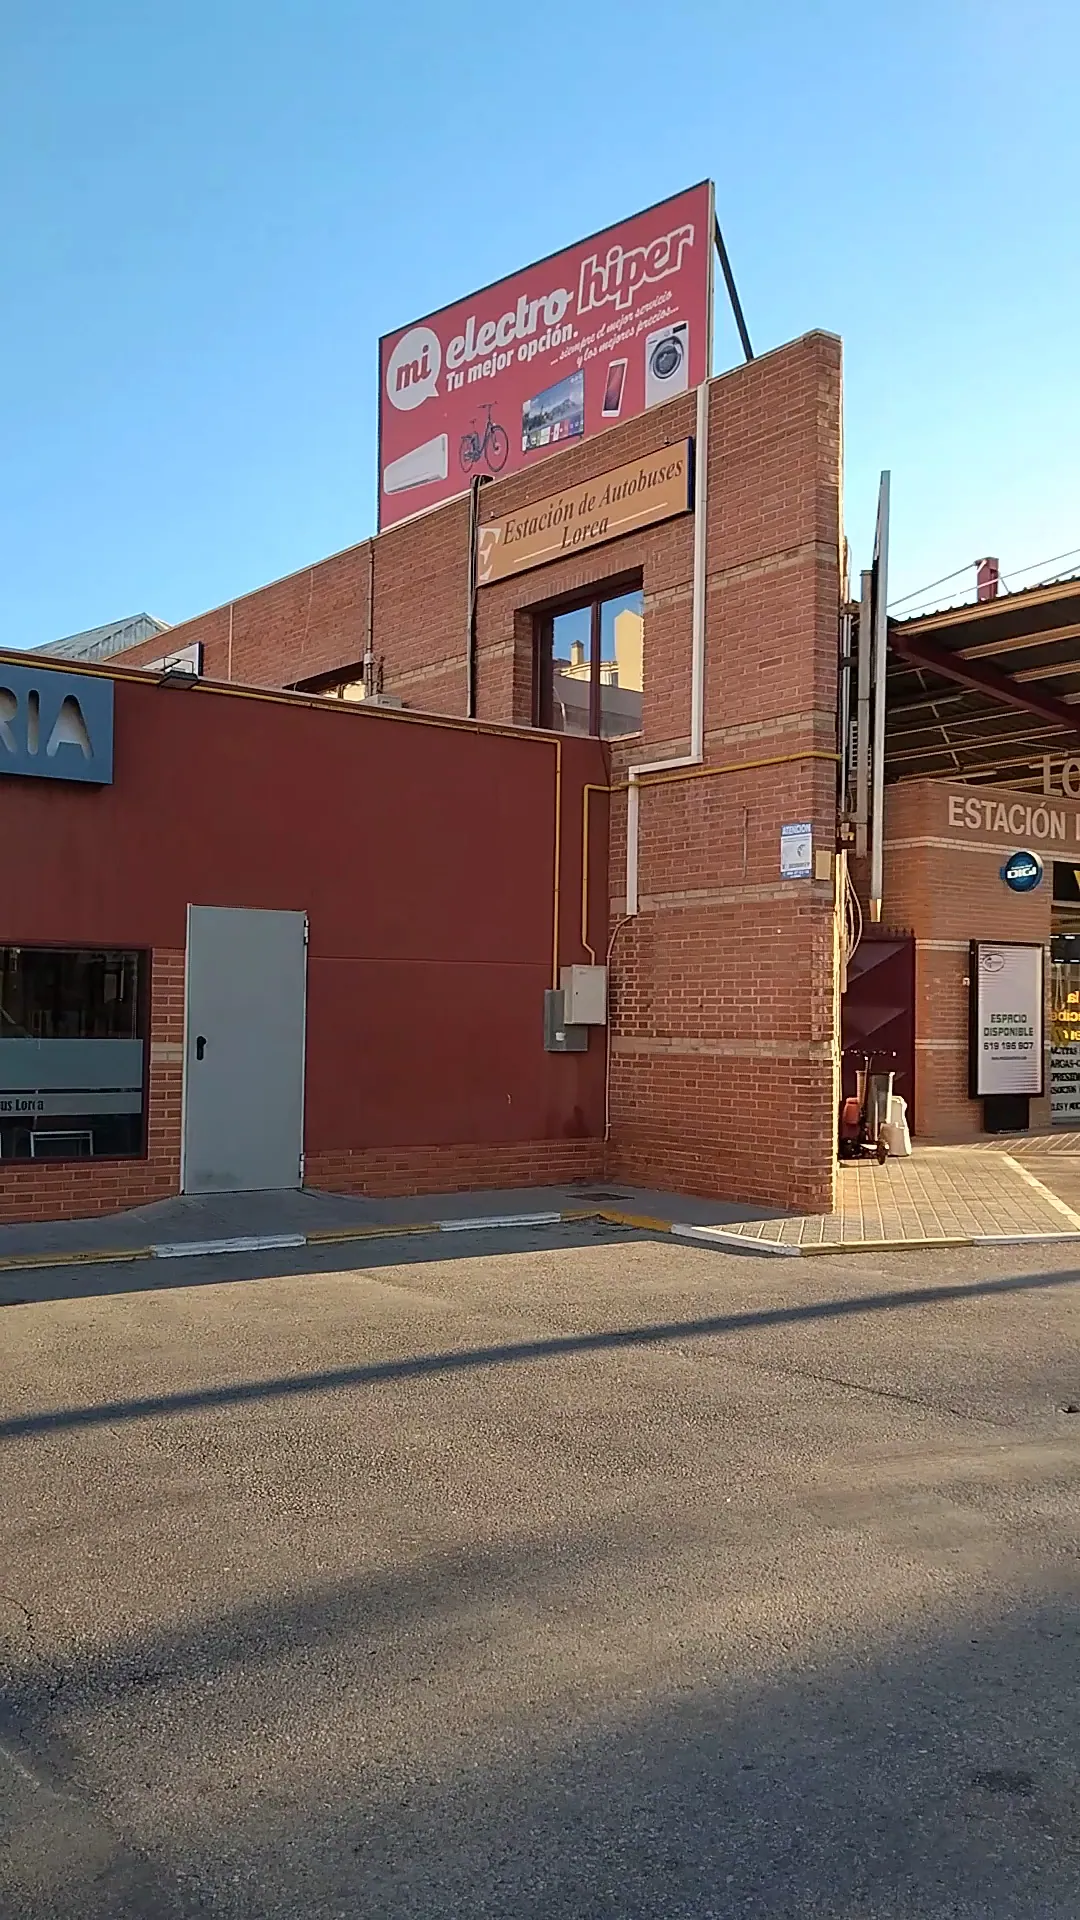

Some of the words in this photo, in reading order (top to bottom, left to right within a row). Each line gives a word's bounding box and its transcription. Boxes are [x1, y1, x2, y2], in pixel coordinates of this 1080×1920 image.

[395, 344, 431, 392] mi
[446, 288, 573, 369] electro
[577, 224, 694, 315] hiper
[596, 323, 606, 340] el
[607, 312, 633, 332] mejor
[635, 291, 672, 318] servicio
[446, 371, 464, 392] Tu
[467, 349, 514, 383] mejor
[518, 323, 579, 361] opción.
[584, 347, 598, 361] los
[599, 327, 635, 350] mejores
[503, 499, 578, 545] Estación
[578, 493, 596, 515] de
[598, 459, 684, 508] Autobuses
[560, 516, 609, 549] Lorca
[949, 795, 1066, 840] ESTACIÓN
[1007, 866, 1037, 879] DIGI
[983, 1027, 1034, 1037] DISPONIBLE
[991, 1014, 1027, 1023] ESPACIO
[15, 1098, 44, 1111] Lorca
